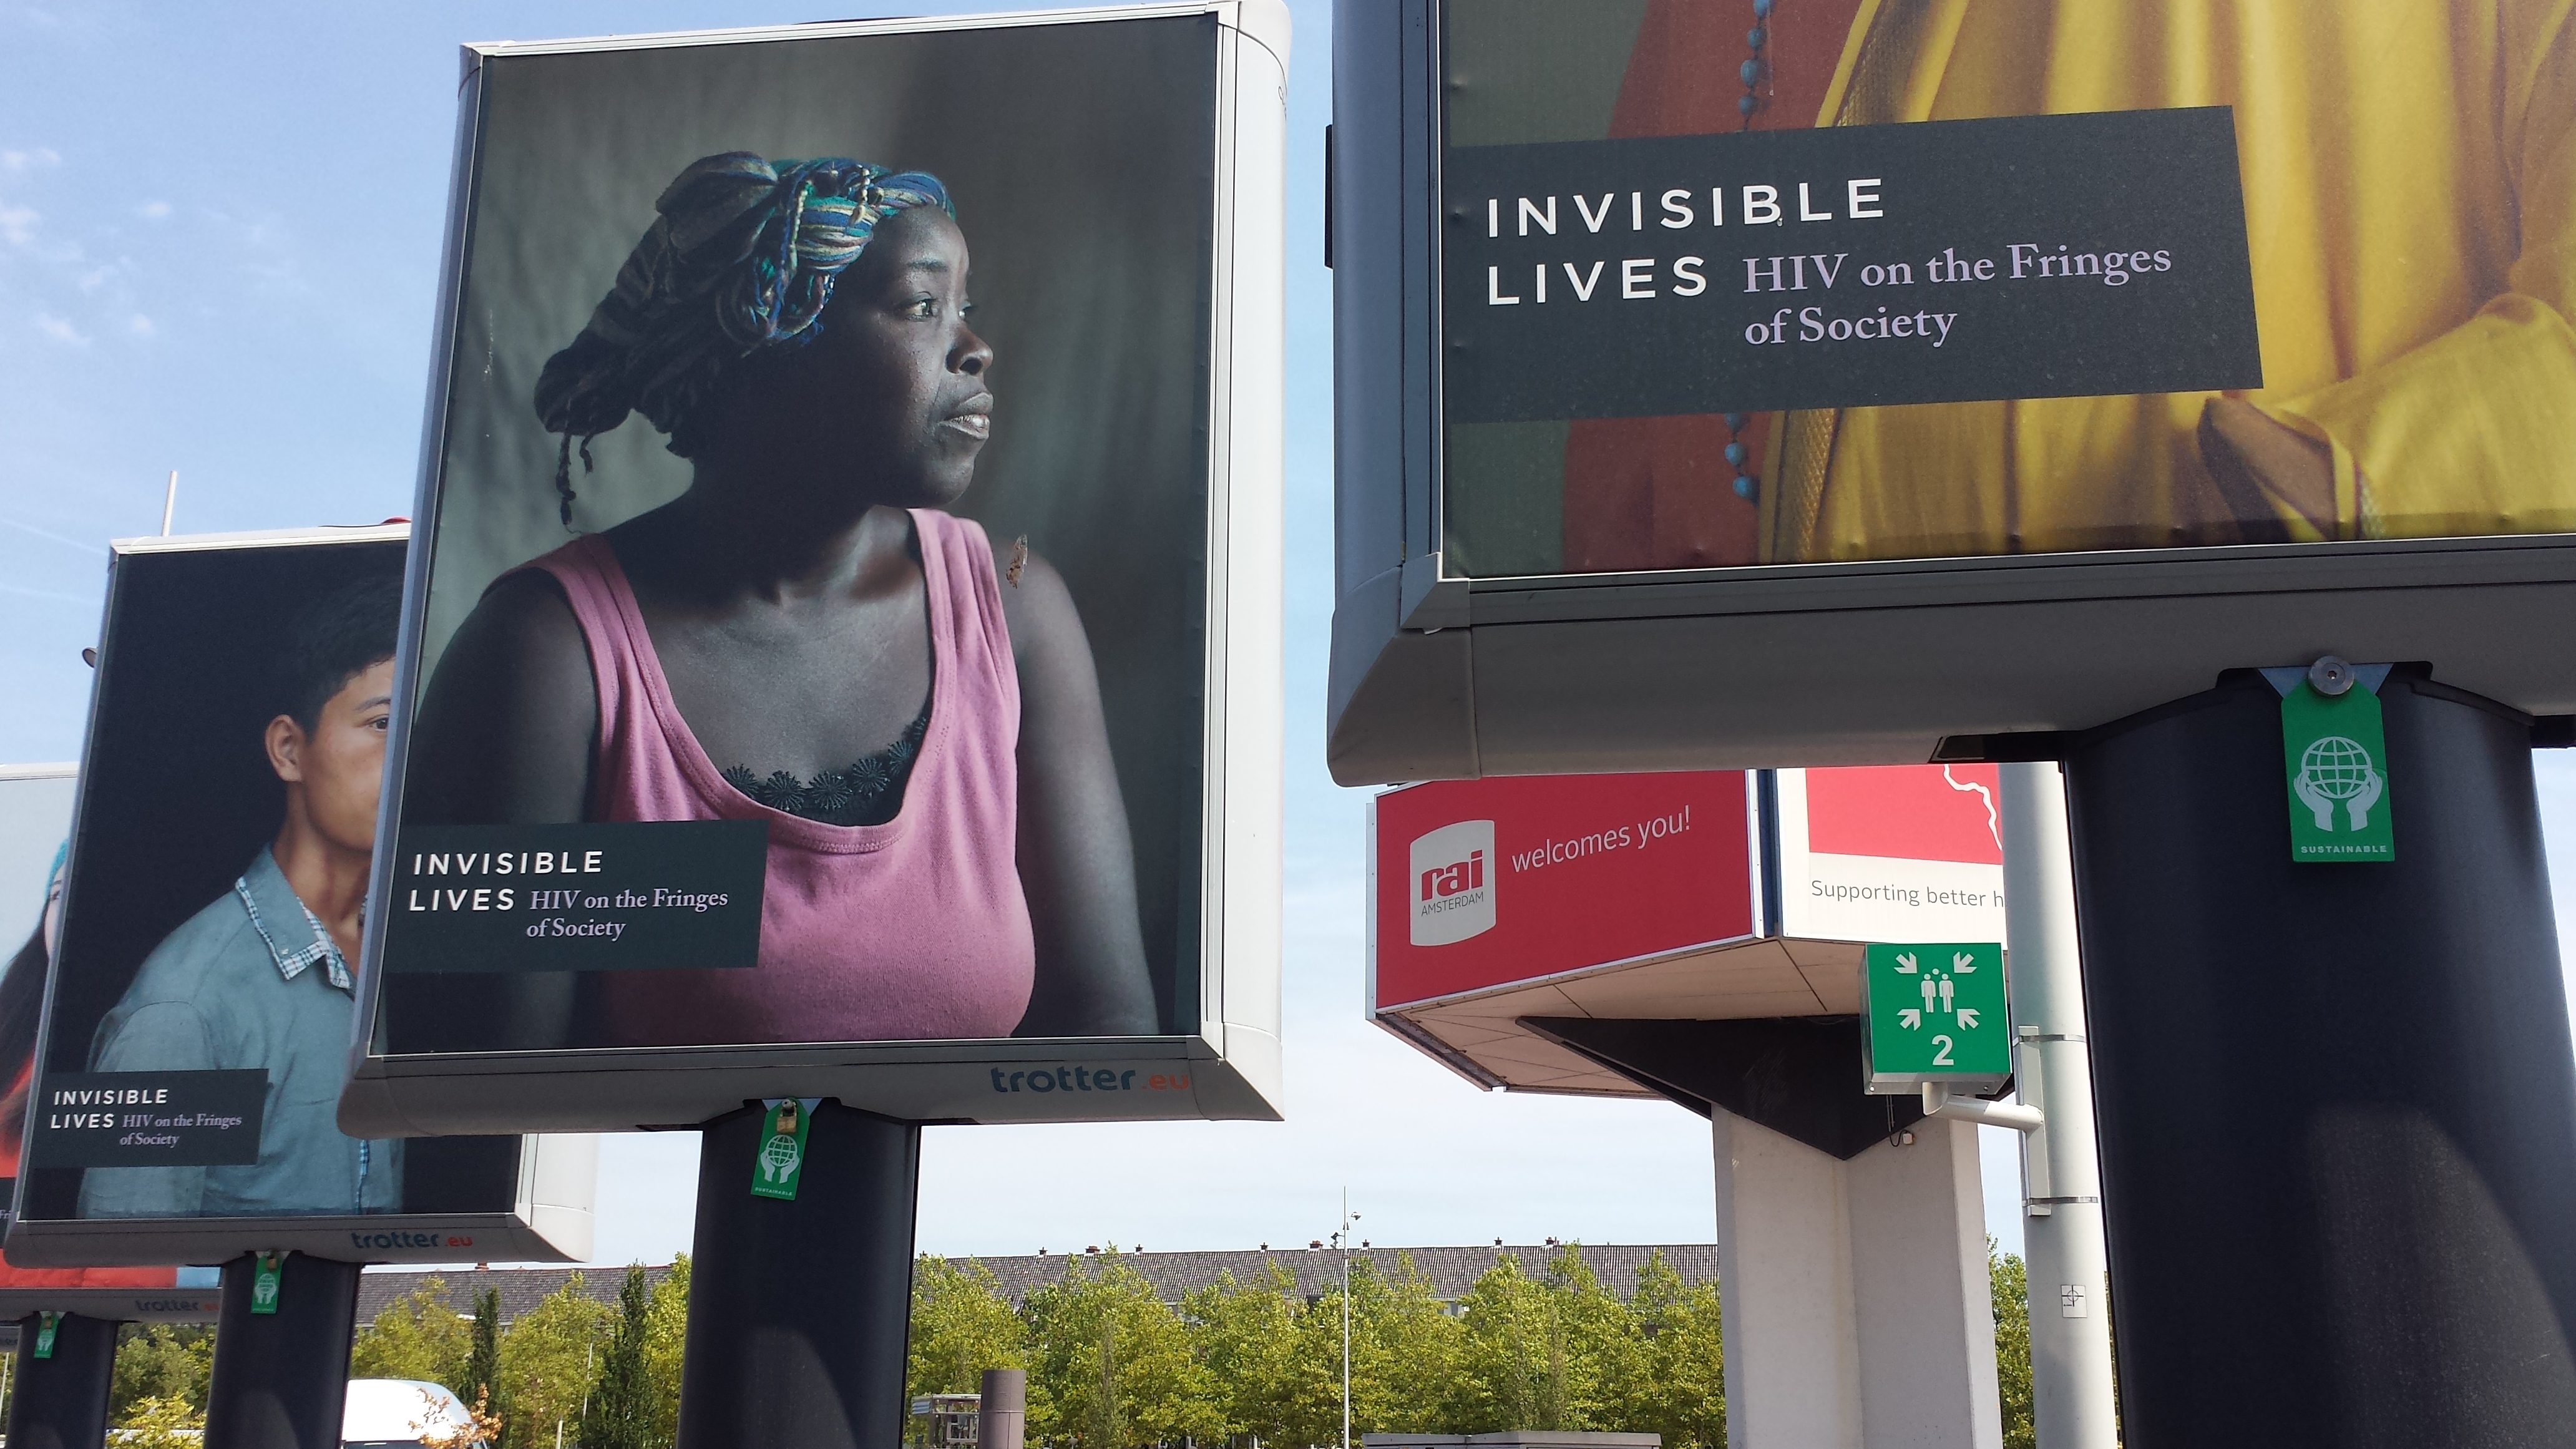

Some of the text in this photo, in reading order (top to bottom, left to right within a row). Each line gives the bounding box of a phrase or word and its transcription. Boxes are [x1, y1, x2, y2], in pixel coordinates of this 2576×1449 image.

[1488, 178, 1883, 238] INVISIBLE
[1742, 242, 2172, 293] HIV on the Fringes
[1488, 256, 1707, 305] LIVES
[1744, 306, 1958, 348] of Society
[1511, 804, 1690, 873] welcomes you!
[2300, 845, 2388, 854] SUSTAINABLE
[413, 851, 603, 876] INVISIBLE
[1422, 849, 1483, 901] rai
[409, 888, 514, 911] LIVES
[529, 888, 728, 912] HIV on the Fringes
[1421, 891, 1484, 917] AMSTERDAM
[1812, 881, 2004, 907] Supporting better h
[526, 917, 626, 942] of Society
[1931, 1035, 1954, 1066] 2
[54, 1088, 168, 1106] INVISIBLE
[50, 1113, 115, 1129] LIVES
[122, 1113, 243, 1130] HIV on the Fringes
[119, 1133, 180, 1149] of Society
